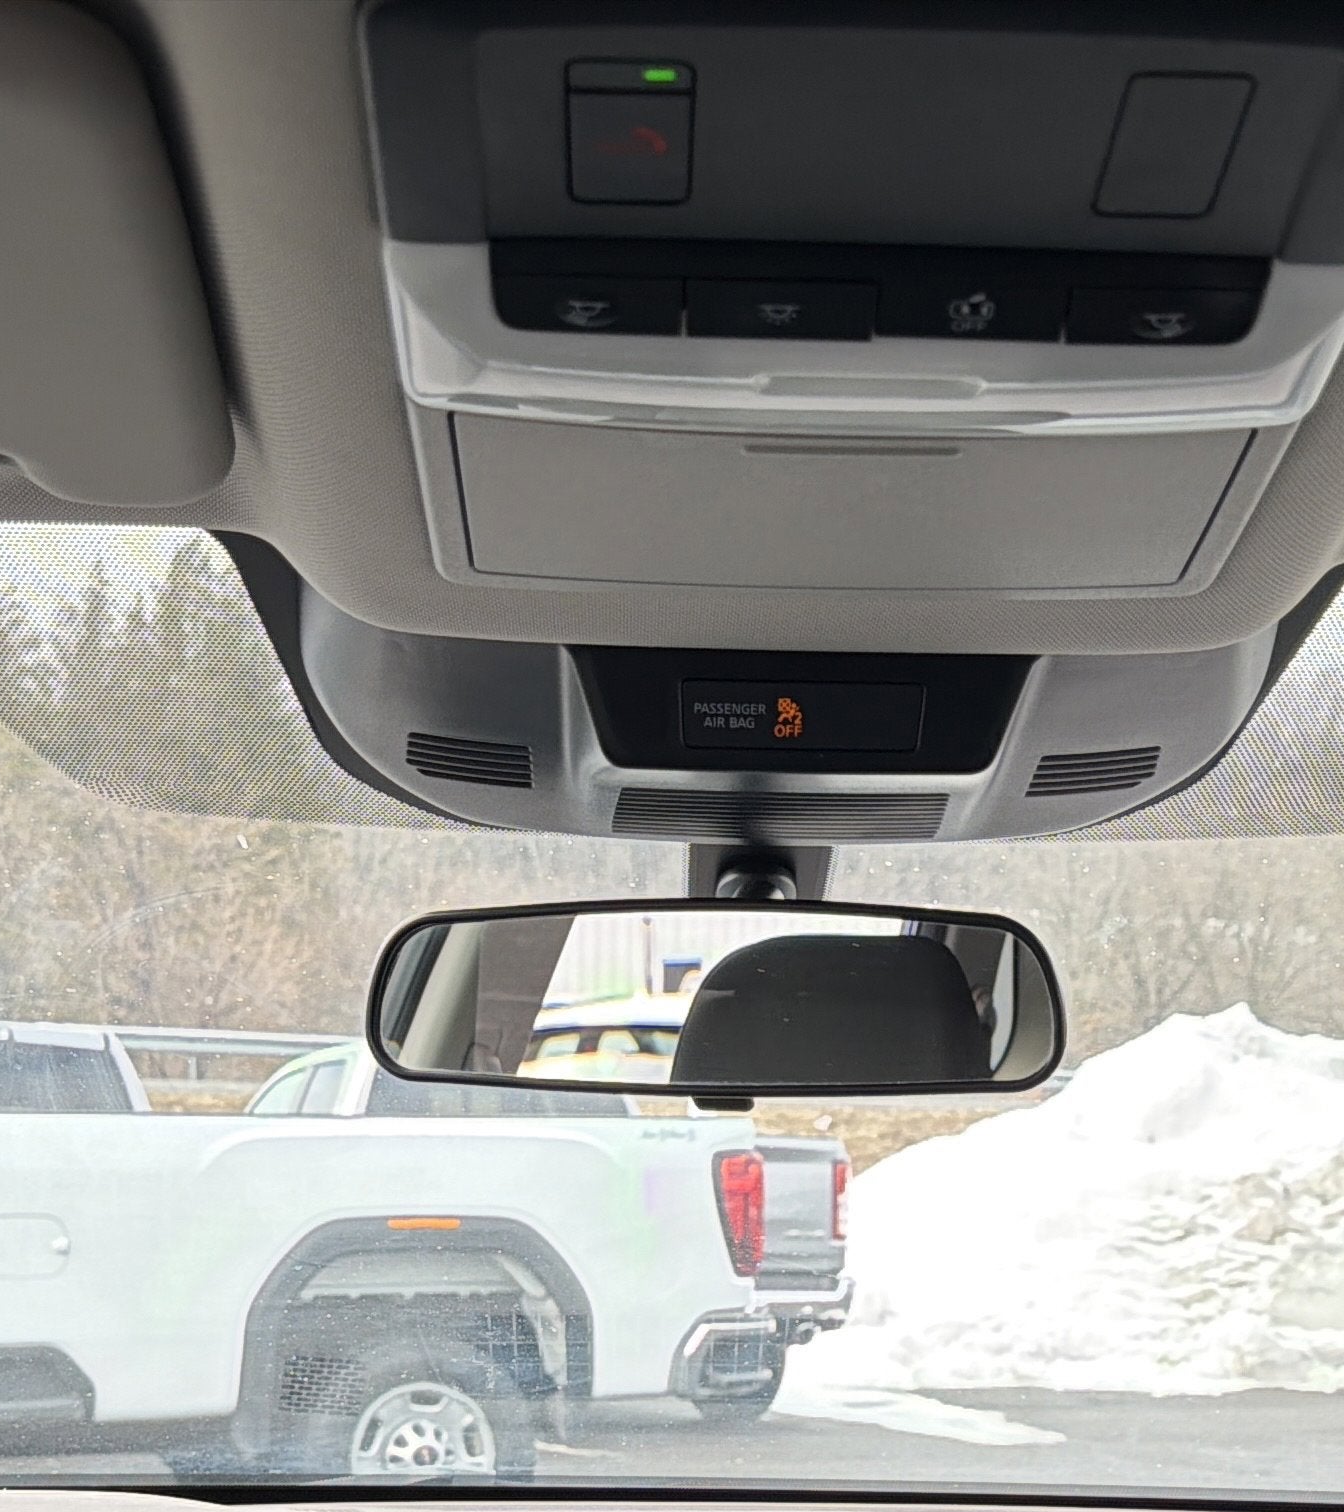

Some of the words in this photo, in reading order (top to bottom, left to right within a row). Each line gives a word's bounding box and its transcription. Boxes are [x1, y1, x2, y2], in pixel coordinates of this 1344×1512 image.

[693, 702, 767, 716] PASSENGER
[703, 716, 726, 729] AIR
[729, 716, 756, 729] BAG
[773, 724, 803, 738] OFF
